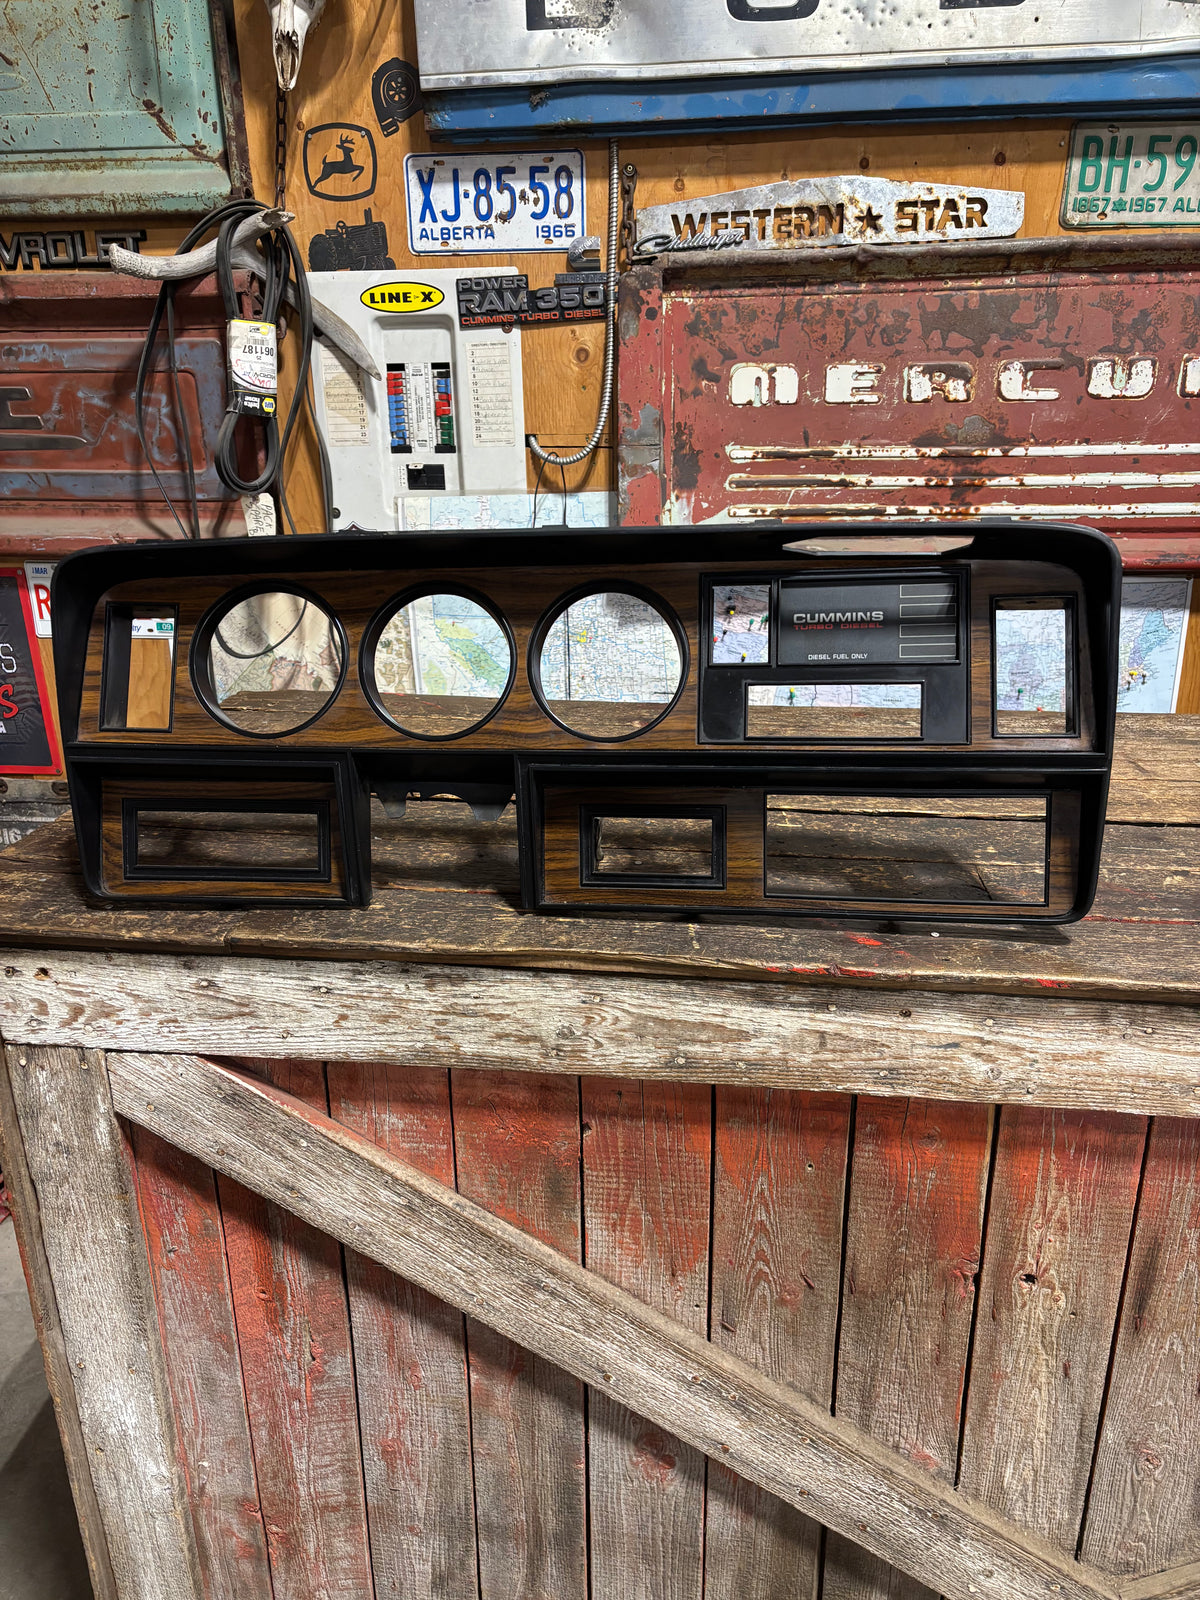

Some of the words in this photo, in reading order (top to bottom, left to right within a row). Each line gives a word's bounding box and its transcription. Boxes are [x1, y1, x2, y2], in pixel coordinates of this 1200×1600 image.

[1071, 197, 1112, 213] 1867
[1129, 197, 1168, 213] 1967
[671, 202, 845, 243] WESTERN
[895, 197, 988, 232] STAR
[419, 225, 496, 241] ALBERTA
[536, 225, 576, 239] 1966
[633, 231, 744, 256] Challenger
[458, 276, 527, 292] POWER
[459, 290, 529, 315] RAM
[536, 284, 605, 310] 350
[461, 314, 515, 325] CUMMINS
[520, 312, 560, 322] TURBO
[564, 309, 605, 319] DIESEL
[242, 344, 275, 357] 061187
[793, 611, 884, 624] CUMMINS
[840, 622, 884, 630] DIESEL
